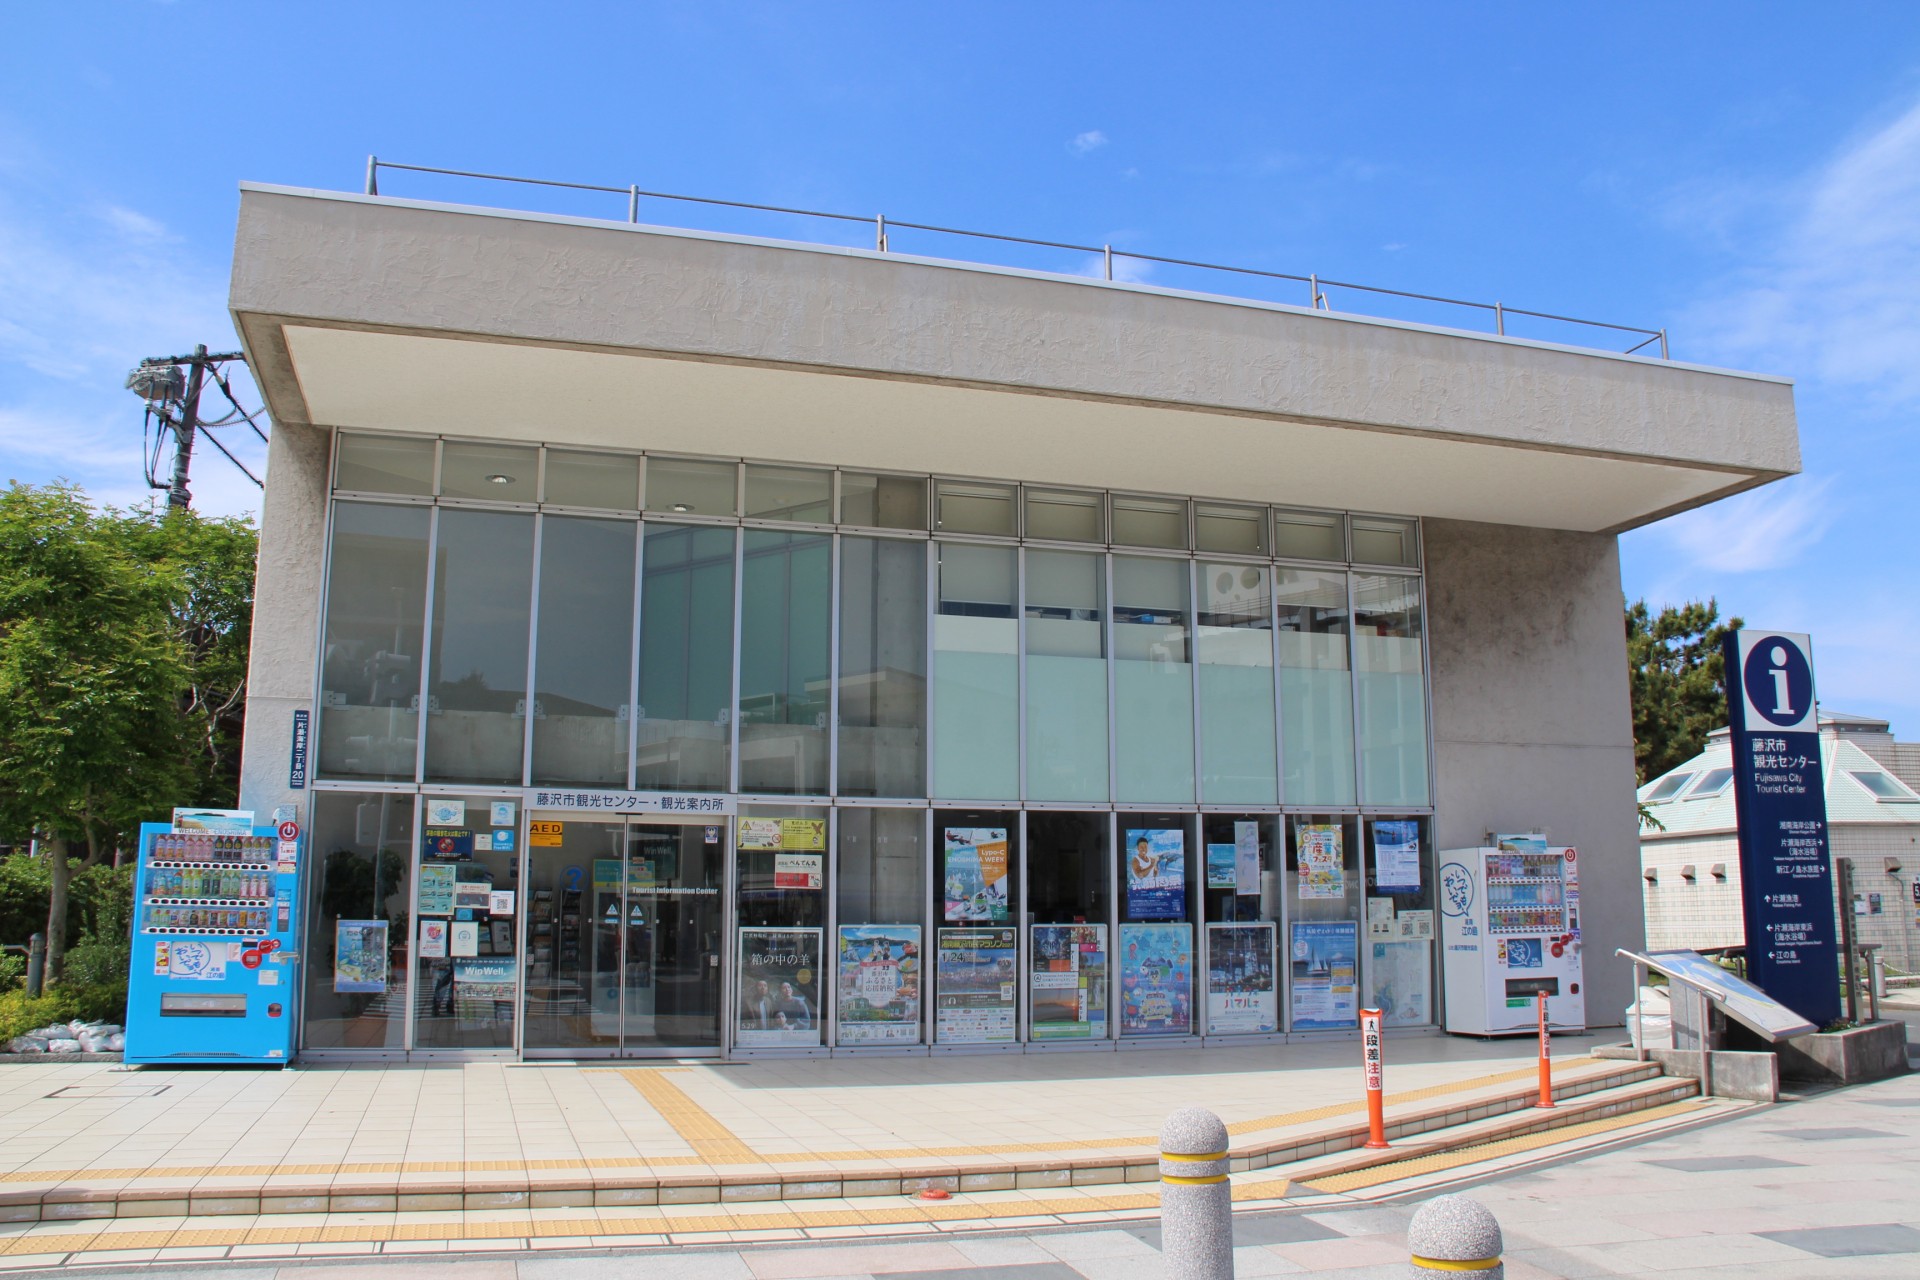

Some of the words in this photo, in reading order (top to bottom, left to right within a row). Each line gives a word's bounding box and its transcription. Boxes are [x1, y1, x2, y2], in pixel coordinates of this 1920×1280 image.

[1752, 738, 1786, 752] 藤沢市
[1753, 755, 1817, 769] 観光センター
[292, 770, 304, 779] 20
[1755, 773, 1788, 784] Fujisawa
[1789, 773, 1802, 784] City
[1755, 784, 1782, 793] Tourist
[1783, 784, 1806, 793] Center
[536, 792, 724, 811] 藤沢市観光センター・観光案内所
[530, 824, 561, 833] AED
[696, 887, 718, 895] Center
[1462, 926, 1478, 936] 江の島
[752, 953, 810, 966] 箱の中の羊
[1776, 951, 1797, 959] 江の島
[865, 977, 893, 985] ふるさと
[1366, 1034, 1380, 1088] 段差注意
